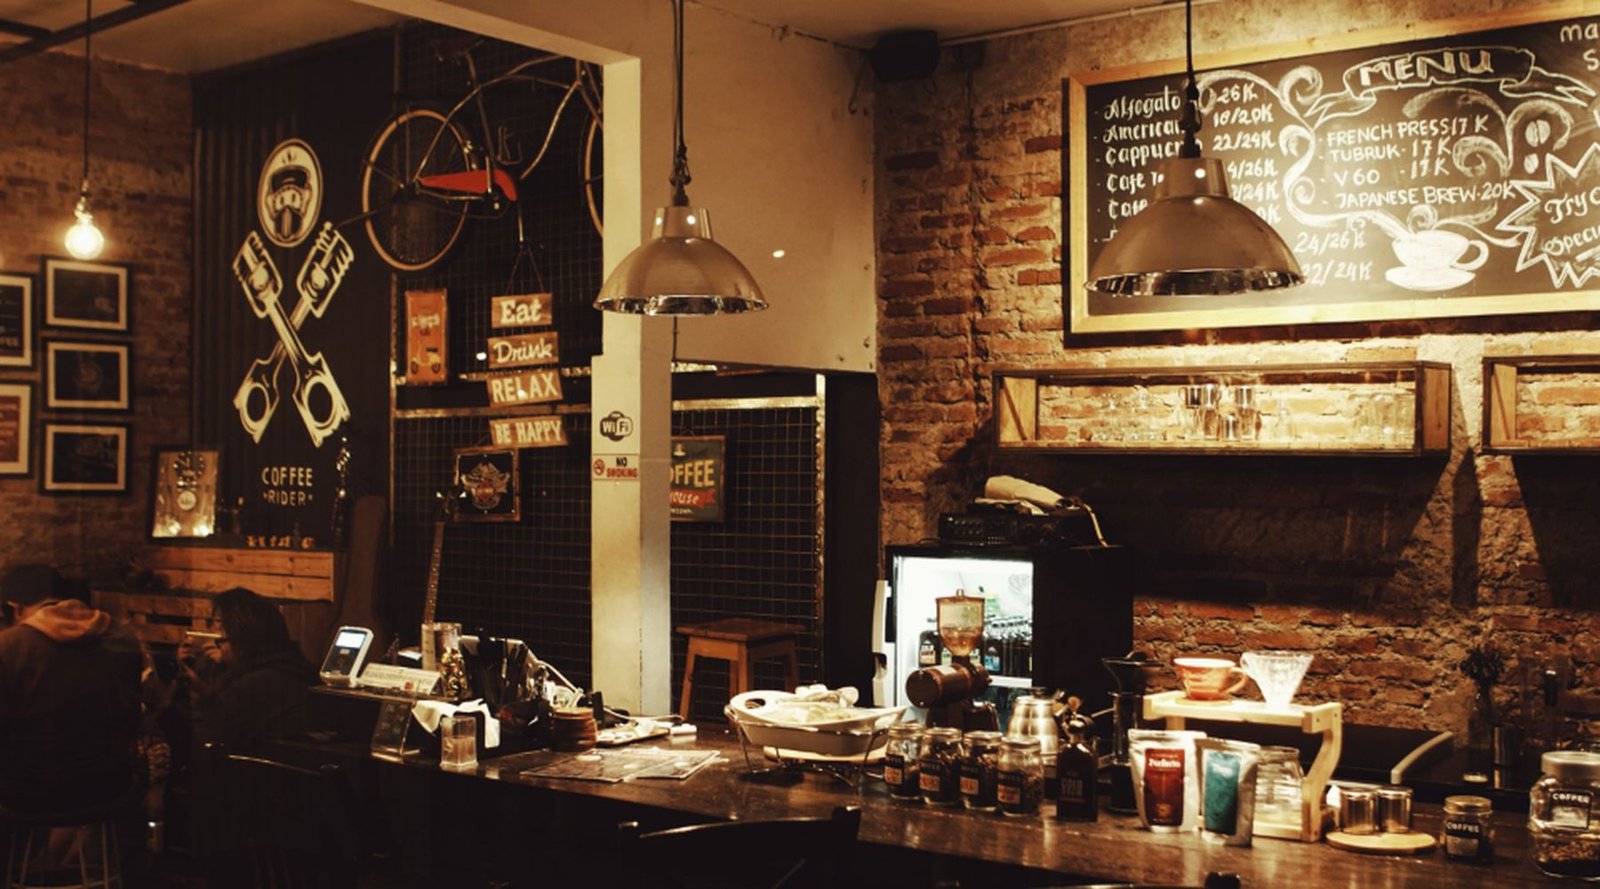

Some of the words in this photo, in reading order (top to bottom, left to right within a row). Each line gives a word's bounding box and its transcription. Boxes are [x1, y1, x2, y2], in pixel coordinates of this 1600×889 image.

[1359, 49, 1494, 86] MENU
[1326, 125, 1392, 147] FRENCH
[1396, 118, 1451, 138] PRESS
[1329, 144, 1400, 163] TUBRUK
[1106, 172, 1147, 195] Cafe
[1336, 187, 1419, 208] JAPANESE
[1423, 184, 1477, 205] BREW
[500, 298, 541, 325] Eat
[493, 338, 552, 364] Drink
[491, 372, 559, 403] RELAX
[495, 422, 512, 444] BE
[515, 419, 562, 443] HAPPY
[607, 467, 638, 478] SMOKING
[616, 456, 628, 467] NO
[261, 466, 313, 488] COFFEE
[669, 459, 715, 488] FFEE
[267, 488, 307, 506] RIDER
[1552, 793, 1591, 804] COFFEE
[1446, 821, 1480, 834] COFFEE
